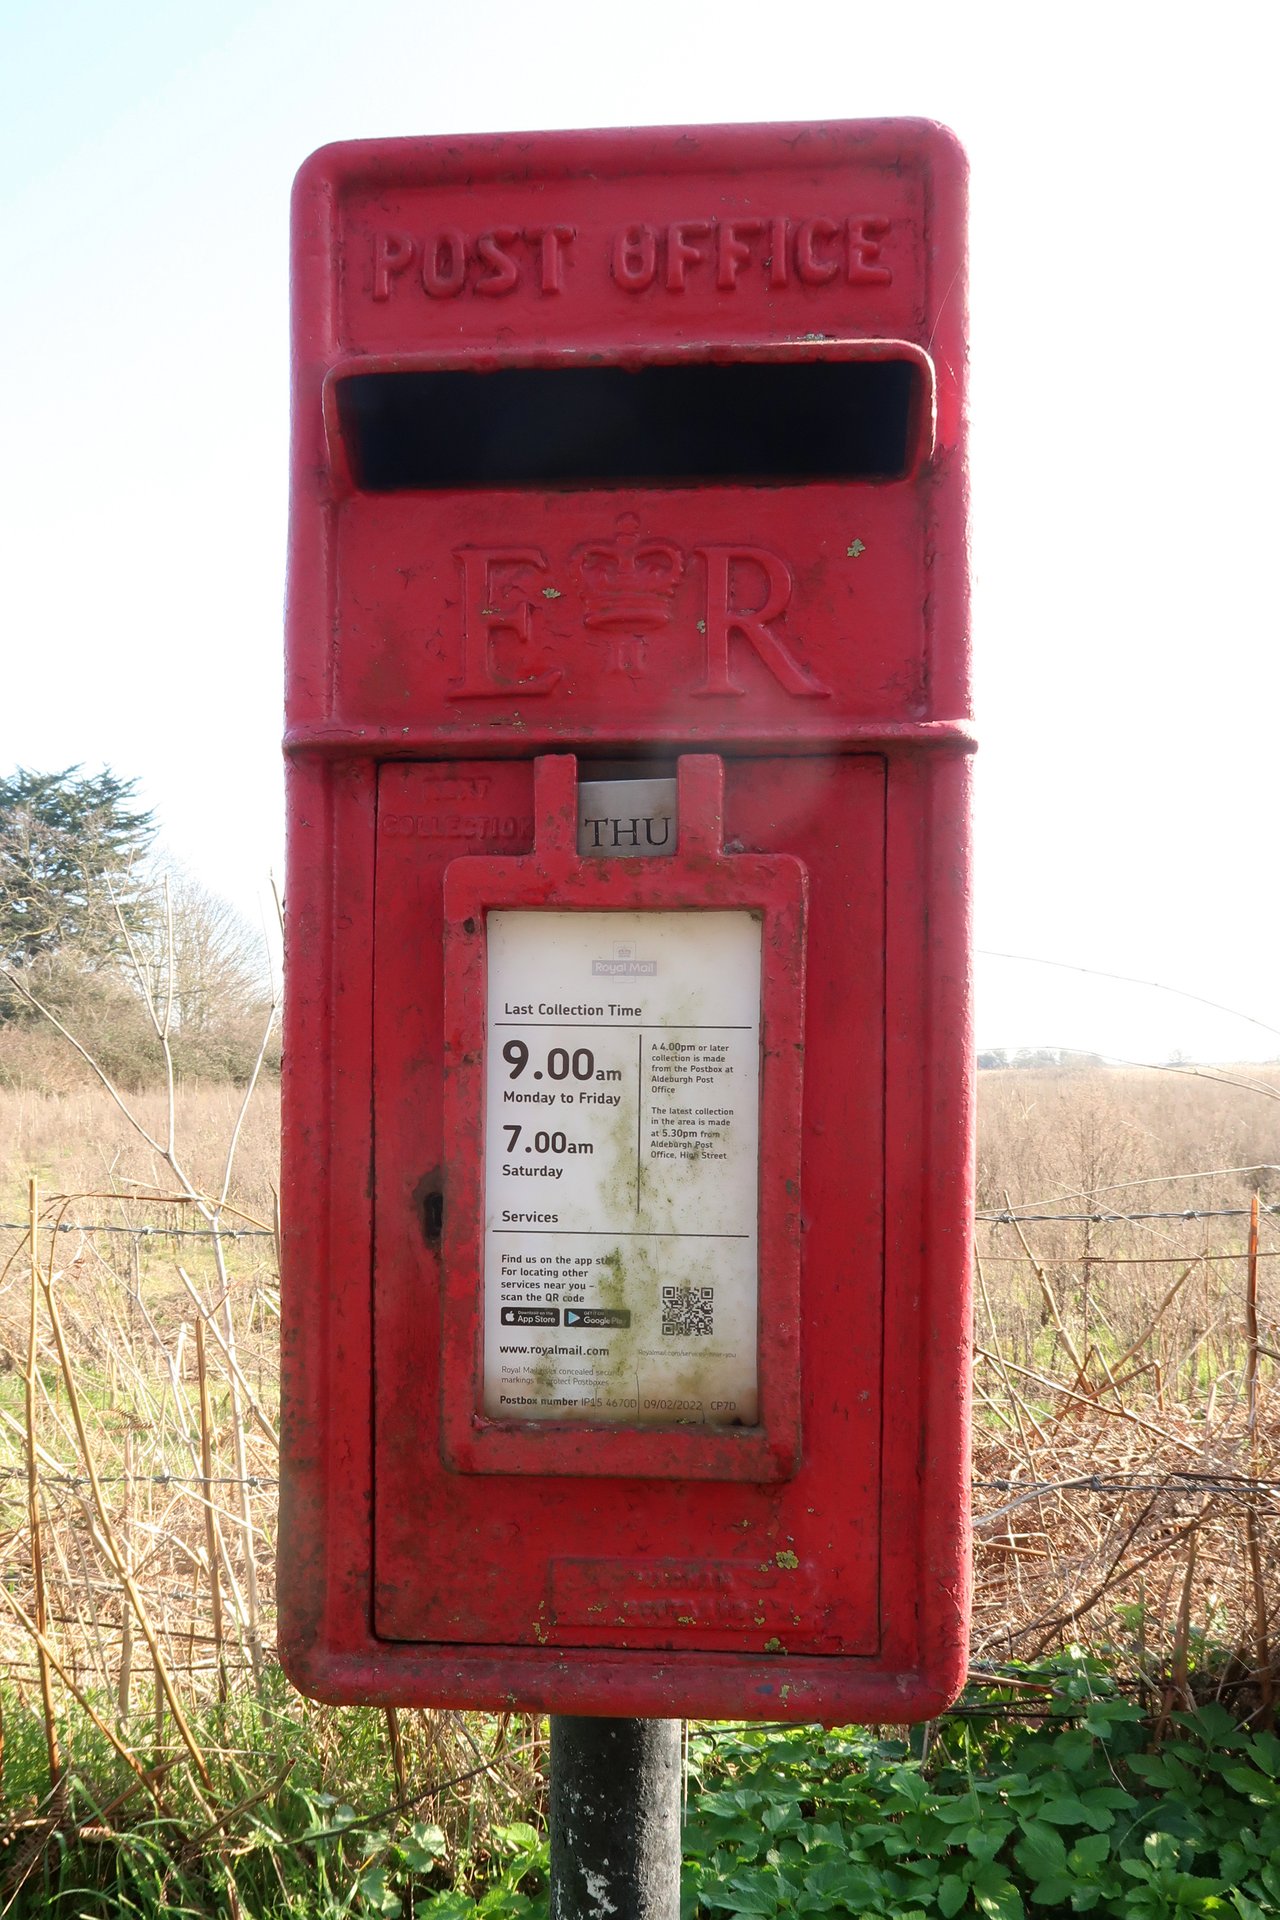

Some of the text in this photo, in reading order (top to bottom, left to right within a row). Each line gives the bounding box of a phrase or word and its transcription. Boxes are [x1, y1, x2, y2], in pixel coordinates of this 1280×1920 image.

[371, 218, 891, 301] POST OFFICE
[446, 545, 831, 699] E R
[585, 817, 672, 847] THU
[595, 962, 653, 974] Royal Mail
[505, 1004, 642, 1016] Last Collection Time
[660, 1043, 695, 1052] 4.00pm
[502, 1040, 622, 1081] 9.00am
[652, 1076, 693, 1084] Aldeburgh
[503, 1091, 621, 1107] Monday to Friday
[662, 1129, 697, 1138] 5.30pm
[502, 1125, 594, 1154] 7.00am
[651, 1141, 692, 1149] Aldeburgh
[502, 1165, 563, 1179] Saturday
[502, 1211, 558, 1223] Services
[502, 1255, 522, 1263] Find
[556, 1255, 571, 1264] the
[575, 1258, 592, 1266] app
[502, 1267, 588, 1278] For locating other
[501, 1280, 540, 1289] services
[544, 1281, 566, 1289] near
[569, 1282, 586, 1291] you
[526, 1293, 541, 1301] the
[546, 1293, 559, 1302] QR
[563, 1294, 584, 1302] code
[584, 1316, 610, 1325] Google
[500, 1345, 609, 1356] www.royalmail.com
[501, 1366, 520, 1374] Royal
[501, 1376, 534, 1384] markings
[500, 1396, 537, 1404] Postbox
[541, 1397, 578, 1406] number
[581, 1398, 603, 1407] IP15
[644, 1400, 702, 1410] 09/02/2022
